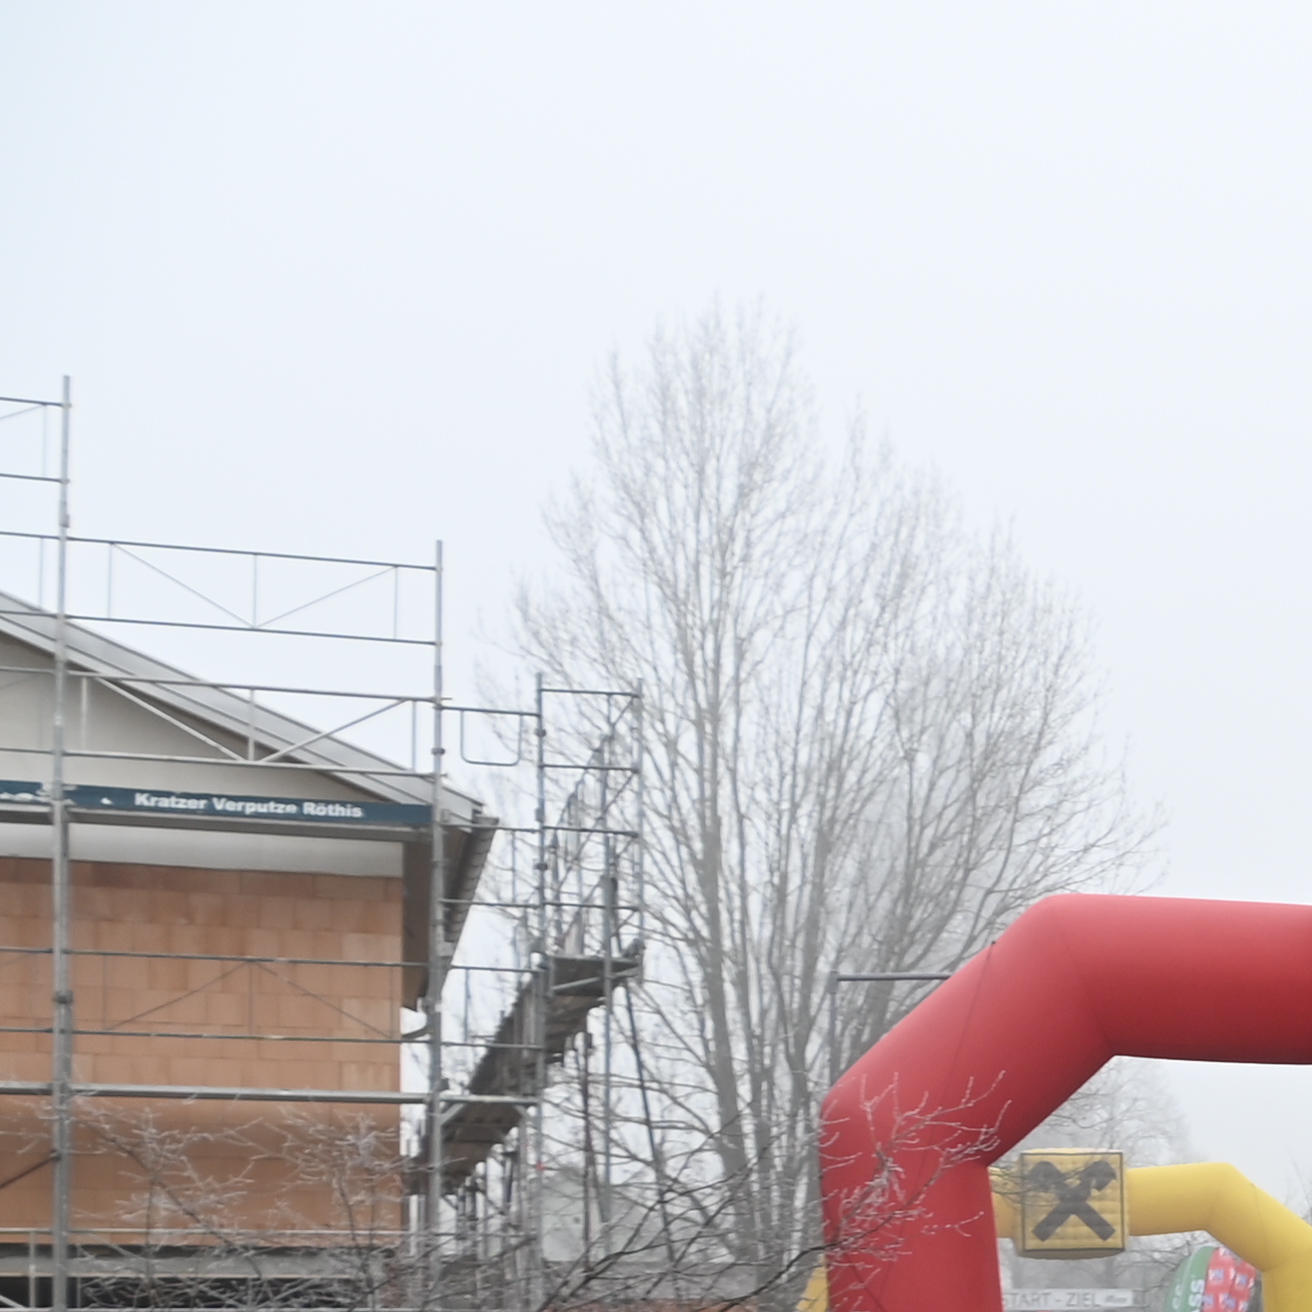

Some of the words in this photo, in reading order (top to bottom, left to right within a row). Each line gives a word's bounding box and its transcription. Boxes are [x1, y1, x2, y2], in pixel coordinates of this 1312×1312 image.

[134, 792, 208, 811] Kratzer
[211, 797, 298, 817] Verputze
[302, 800, 364, 819] Röthis
[1066, 1290, 1101, 1308] ZIEL
